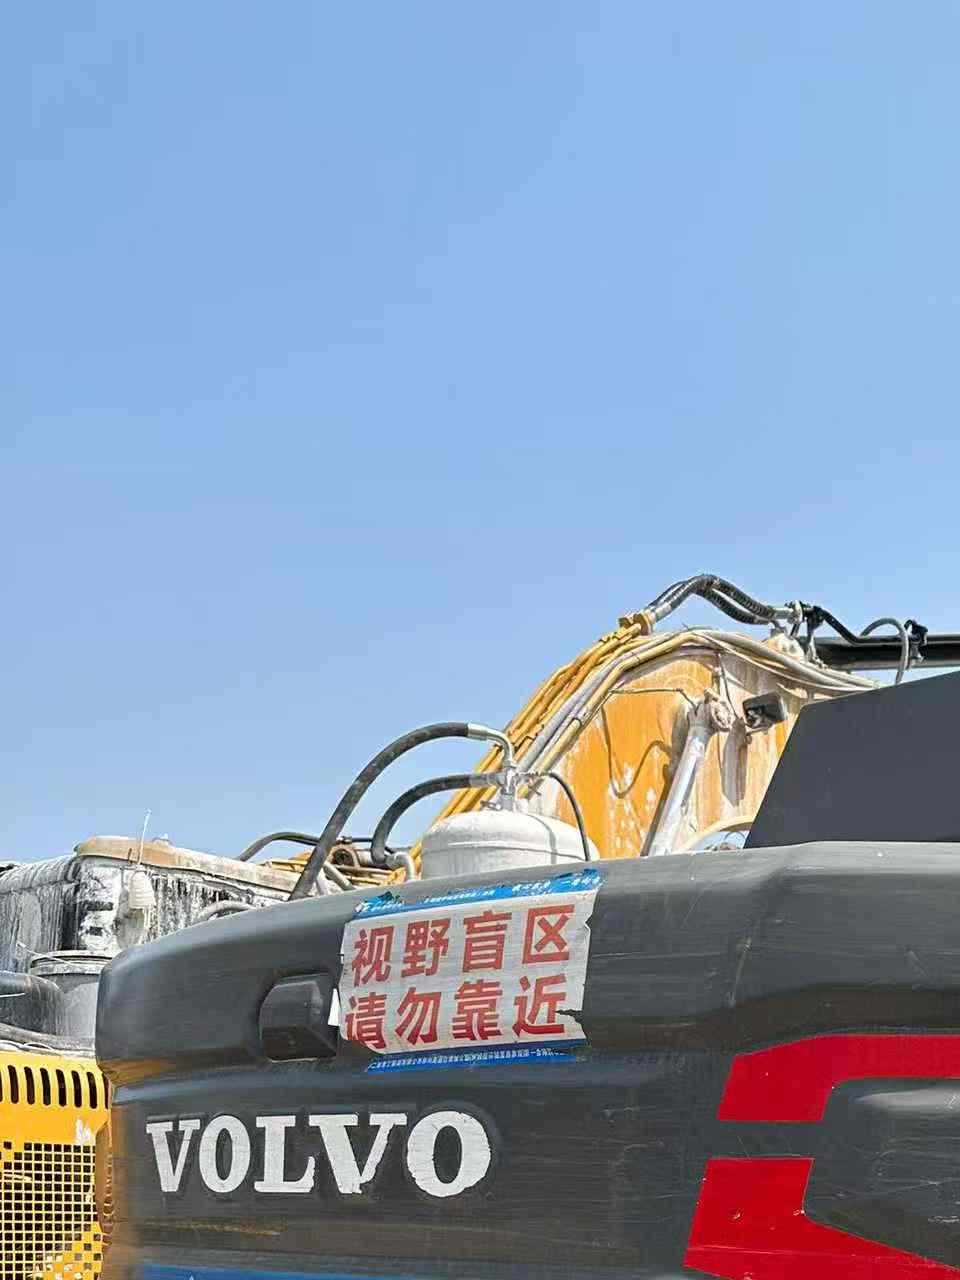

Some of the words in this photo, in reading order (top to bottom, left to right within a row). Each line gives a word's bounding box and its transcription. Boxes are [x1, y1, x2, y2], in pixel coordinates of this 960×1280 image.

[351, 904, 575, 988] 视野盲区
[344, 973, 567, 1050] 请勿靠近
[146, 1111, 491, 1197] VOLVO
